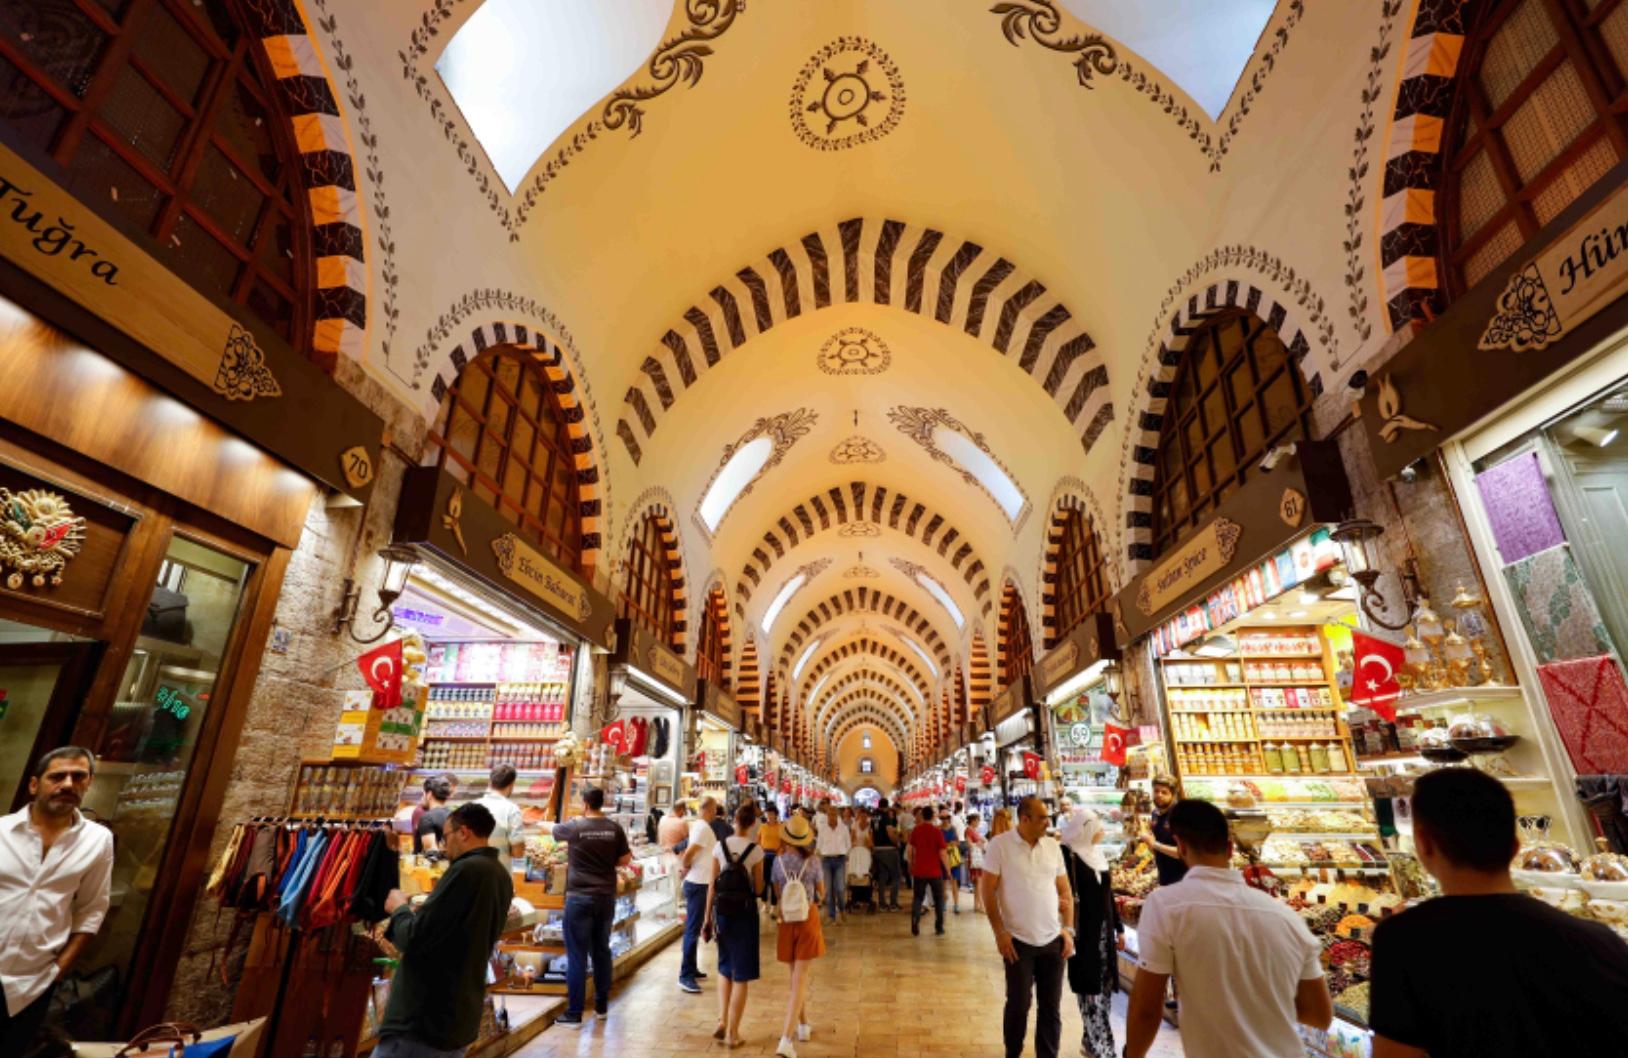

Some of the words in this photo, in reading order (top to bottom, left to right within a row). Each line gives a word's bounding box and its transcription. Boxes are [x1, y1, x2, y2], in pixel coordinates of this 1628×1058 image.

[0, 175, 119, 286] Tuğra
[349, 453, 368, 479] 70
[1284, 496, 1297, 518] 61
